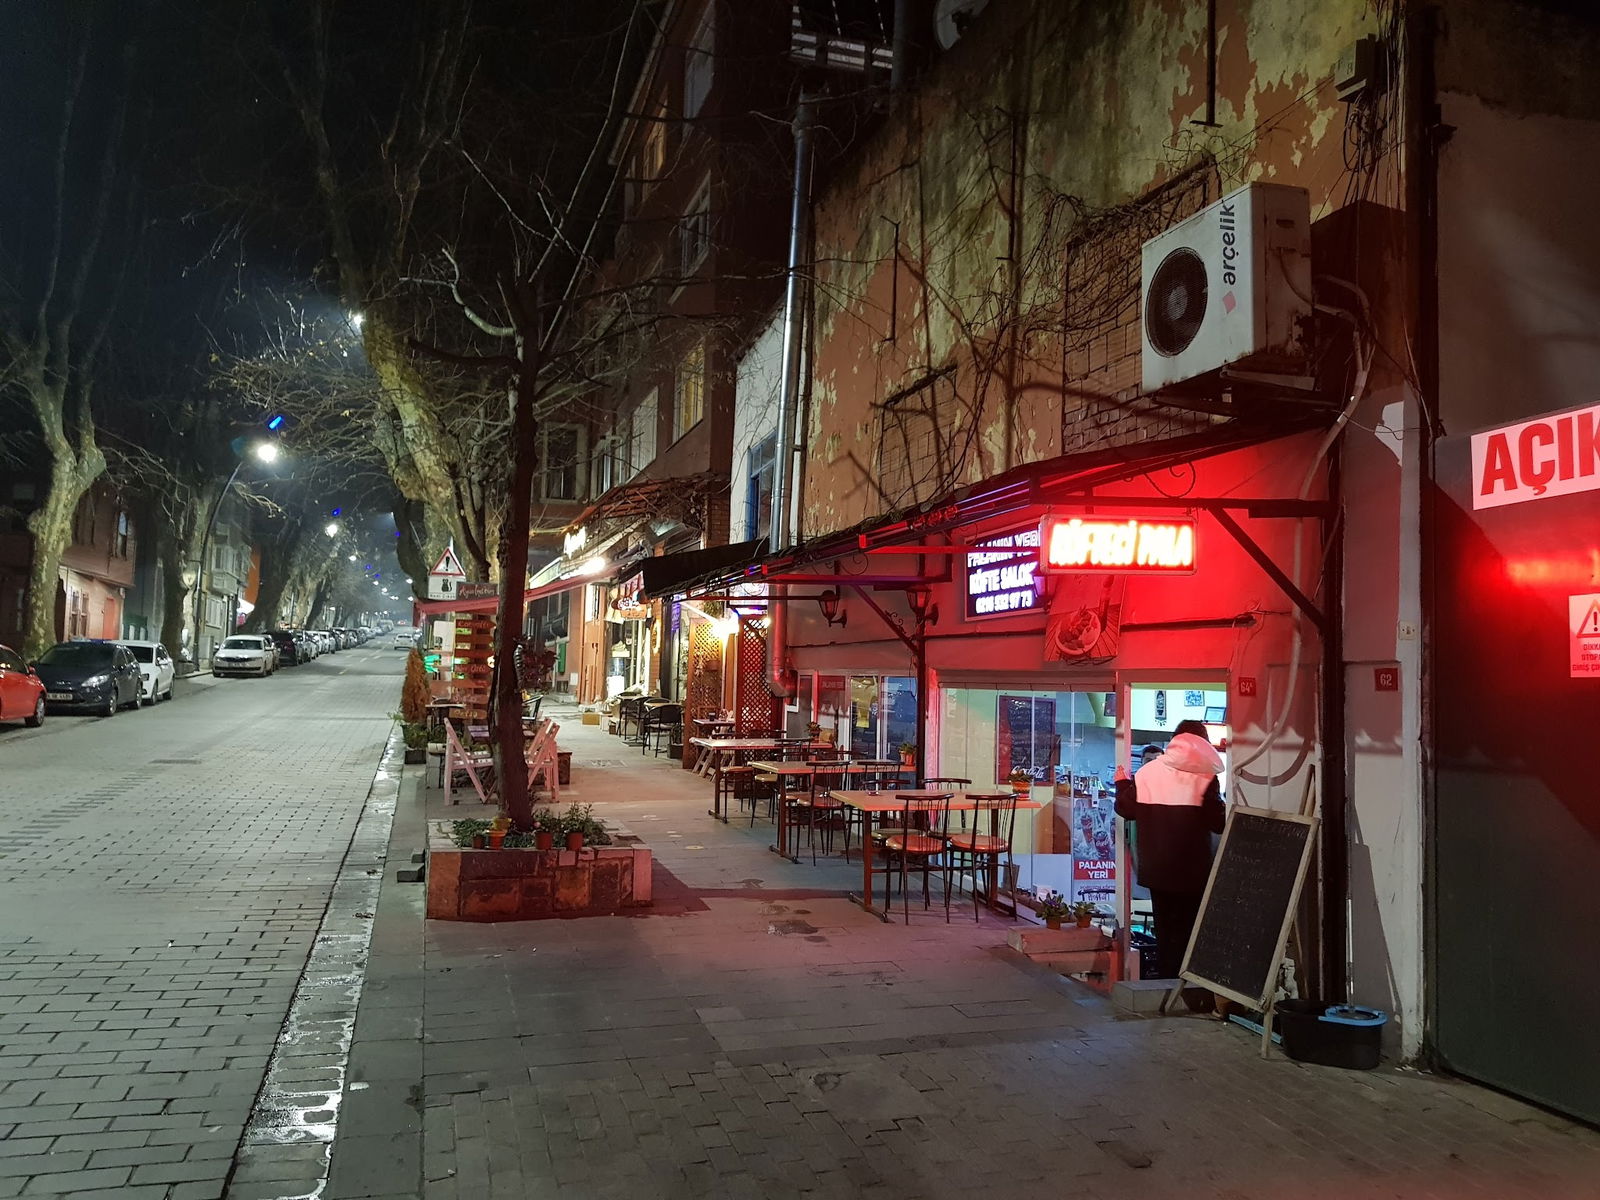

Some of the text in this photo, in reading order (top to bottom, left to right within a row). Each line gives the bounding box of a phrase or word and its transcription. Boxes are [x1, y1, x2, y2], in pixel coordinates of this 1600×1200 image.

[1219, 203, 1239, 286] arçelik
[1137, 525, 1192, 566] PALA
[969, 568, 1000, 595] KÖFTE
[1379, 673, 1393, 686] 62
[1078, 860, 1116, 870] PALANIN
[1087, 869, 1109, 879] YERİ
